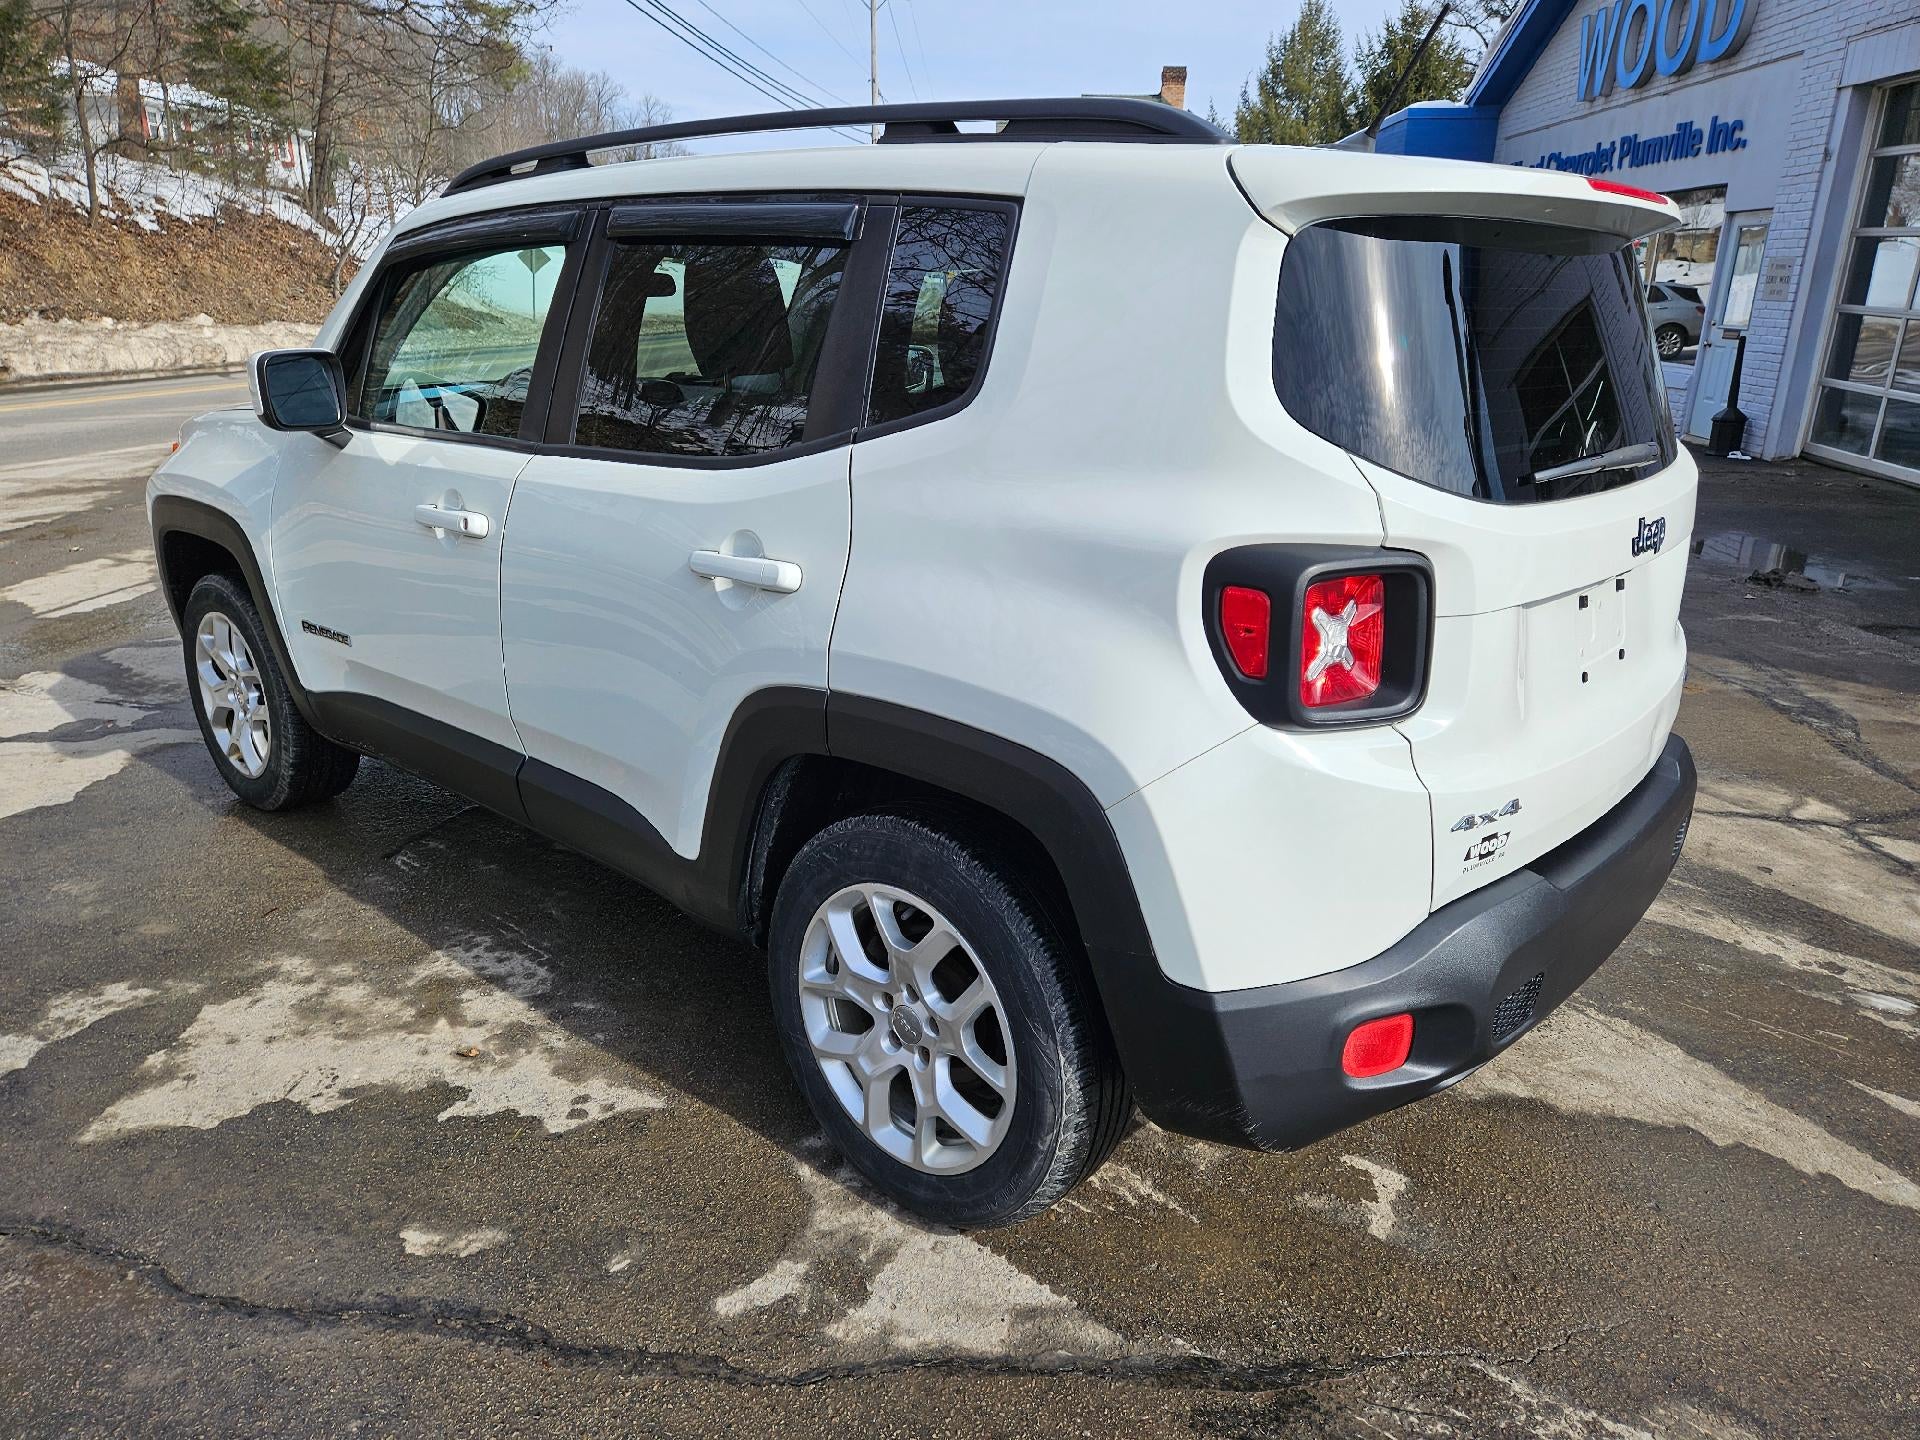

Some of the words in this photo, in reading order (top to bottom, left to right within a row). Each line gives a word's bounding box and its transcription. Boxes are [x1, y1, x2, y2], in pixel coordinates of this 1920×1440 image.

[1577, 0, 1754, 102] WOOD
[1617, 120, 1704, 170] Plumville
[1705, 115, 1748, 155] Inc.
[301, 619, 353, 647] RENEGADE
[1465, 832, 1510, 861] WOOD
